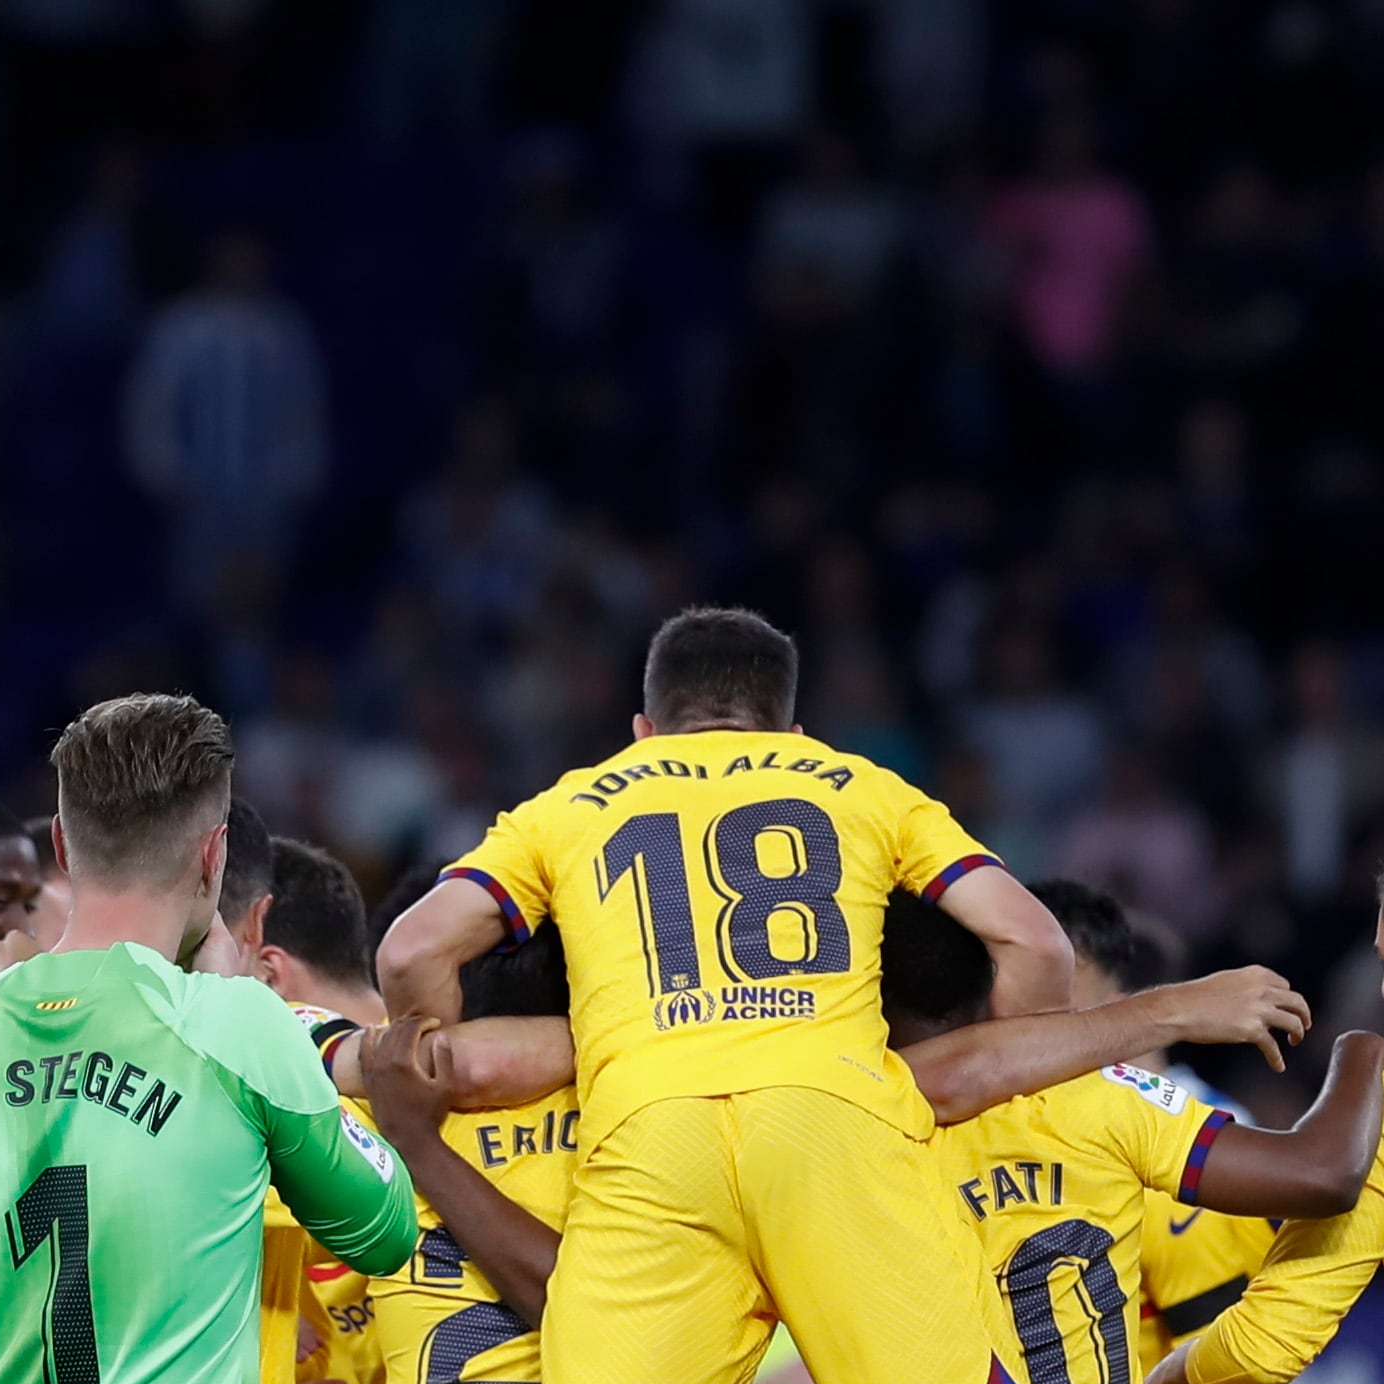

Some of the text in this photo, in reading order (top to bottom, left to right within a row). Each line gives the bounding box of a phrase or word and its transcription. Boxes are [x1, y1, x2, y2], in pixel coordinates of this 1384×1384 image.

[570, 751, 856, 810] JORDI ALBA
[594, 798, 852, 999] 18
[721, 986, 815, 1006] UNHCR
[5, 1050, 183, 1138] STEGEN
[477, 1110, 579, 1169] ERIC
[958, 1162, 1063, 1221] FATI
